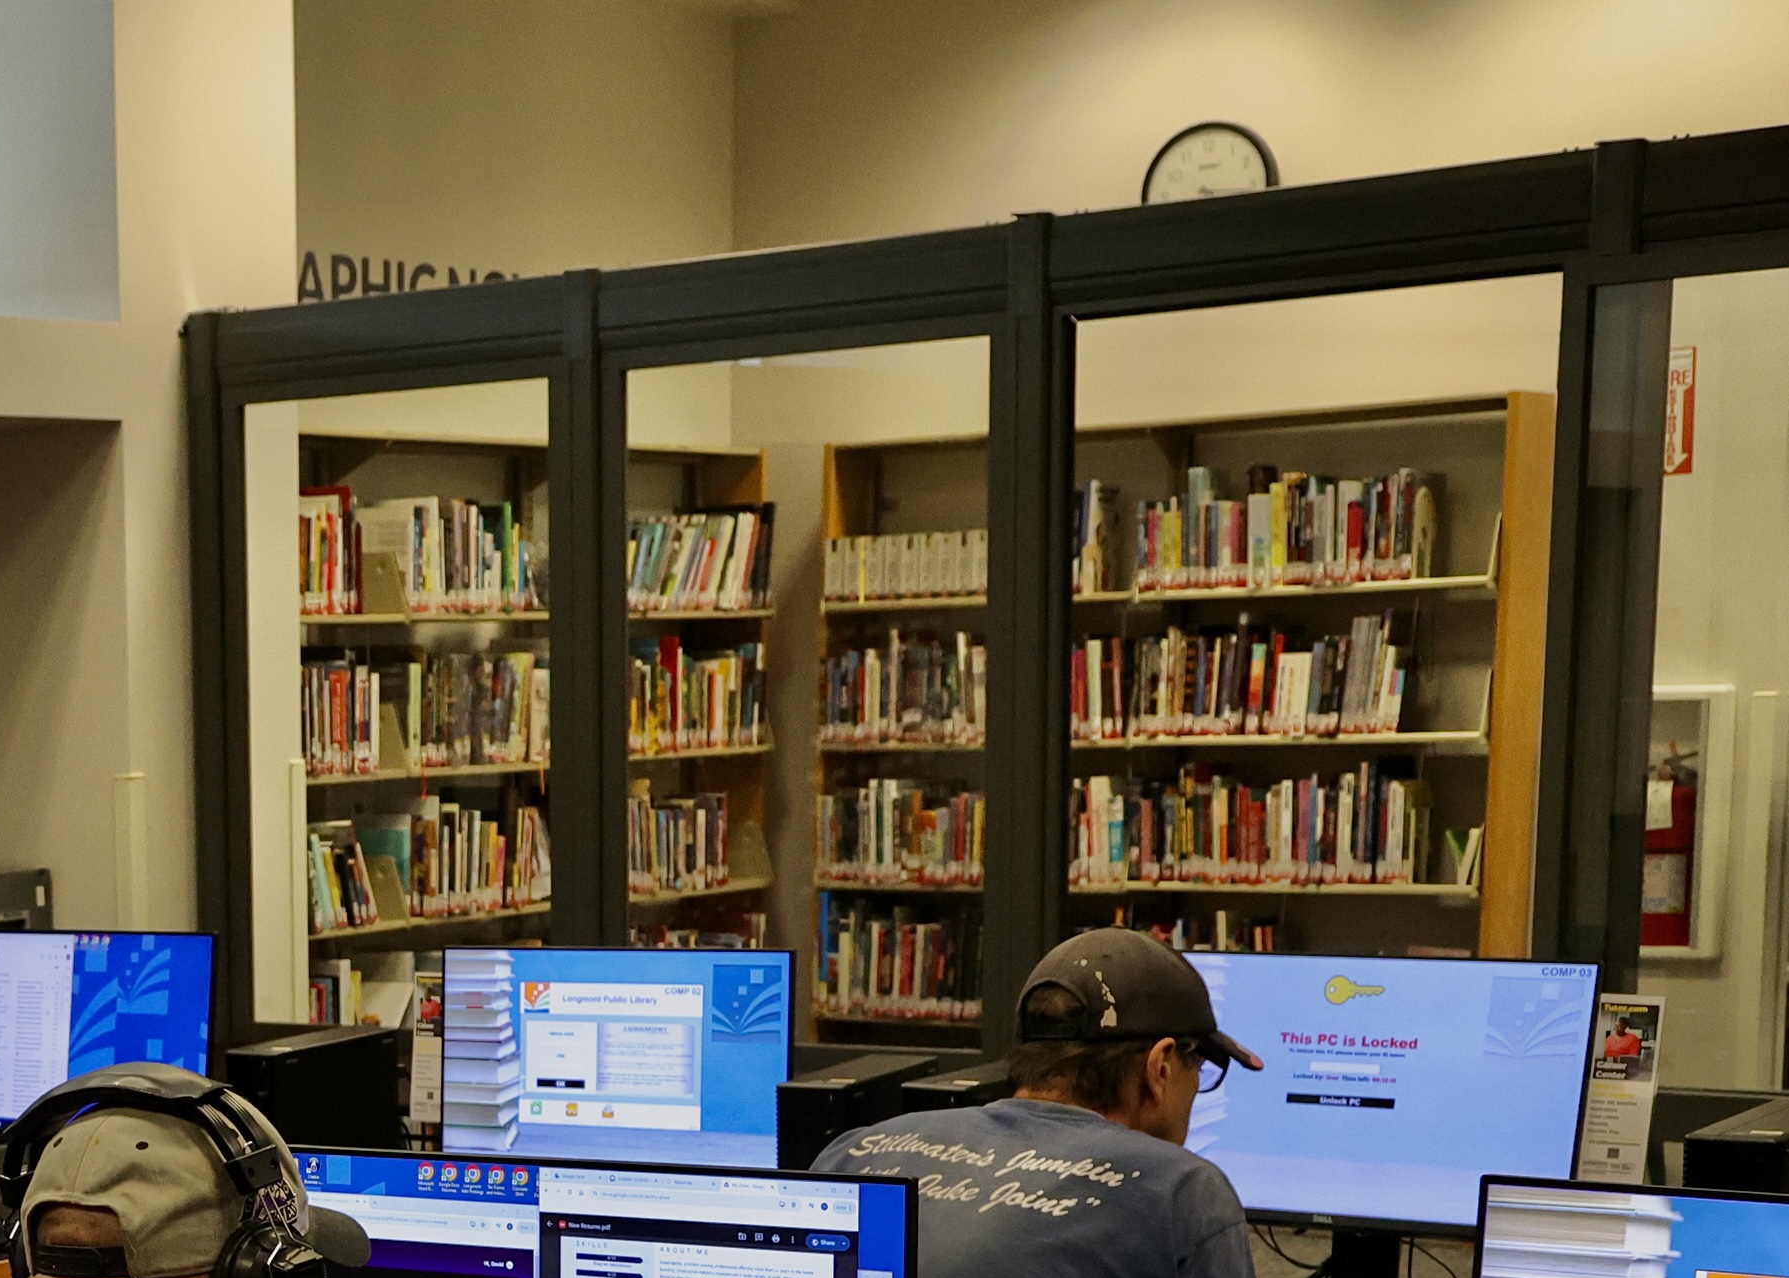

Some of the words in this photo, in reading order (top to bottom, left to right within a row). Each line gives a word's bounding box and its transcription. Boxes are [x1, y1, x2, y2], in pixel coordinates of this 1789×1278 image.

[1541, 967, 1575, 978] COMP
[1577, 968, 1592, 978] 03
[665, 987, 690, 996] COMP
[692, 988, 701, 996] 02
[562, 994, 601, 1004] Longmont
[603, 995, 627, 1003] Public
[630, 995, 657, 1005] Library
[1604, 1004, 1648, 1013] Tutor.com
[1281, 1033, 1312, 1045] This
[1318, 1034, 1338, 1045] PC
[1343, 1035, 1356, 1046] is
[1362, 1036, 1418, 1049] Locked
[1595, 1070, 1626, 1079] Center
[1320, 1097, 1347, 1105] Unlock
[848, 1133, 996, 1168] Stillwater's
[918, 1173, 981, 1202] Juke
[580, 1222, 611, 1231] Resume.pdf
[576, 1240, 608, 1249] SKILLS
[660, 1246, 691, 1254] ABOUT
